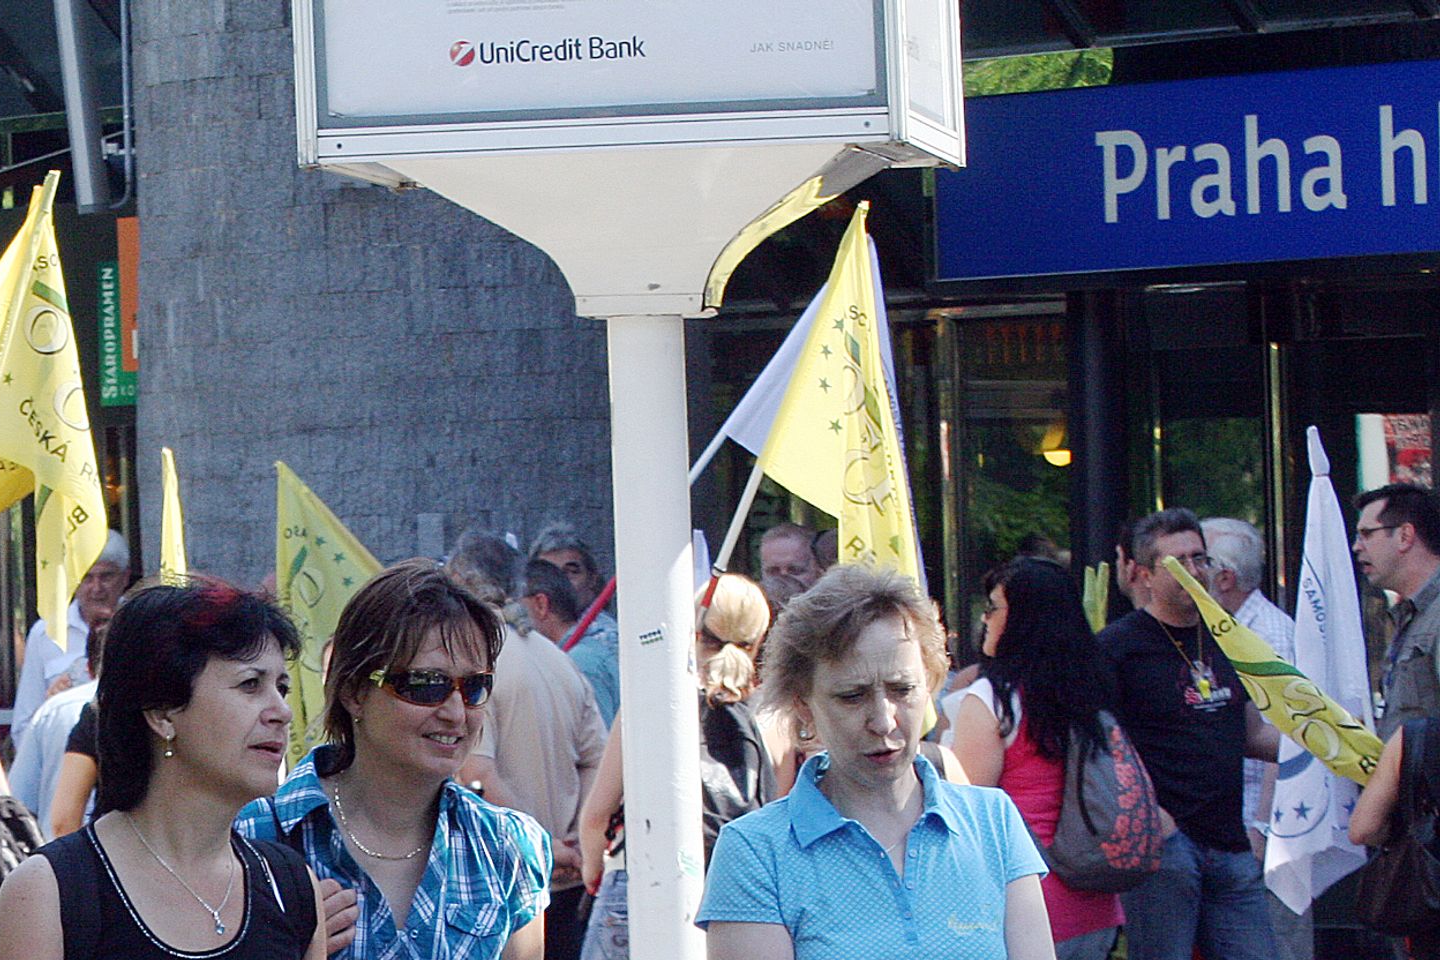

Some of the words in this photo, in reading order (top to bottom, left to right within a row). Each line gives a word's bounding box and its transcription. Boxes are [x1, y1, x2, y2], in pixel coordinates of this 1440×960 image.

[479, 38, 583, 64] UniCredit
[588, 35, 647, 60] Bank
[750, 42, 774, 53] JAK
[1094, 114, 1348, 223] Praha
[1378, 101, 1440, 207] h
[101, 267, 118, 399] STAROPRAMEN
[19, 396, 72, 463] ČESKÁ
